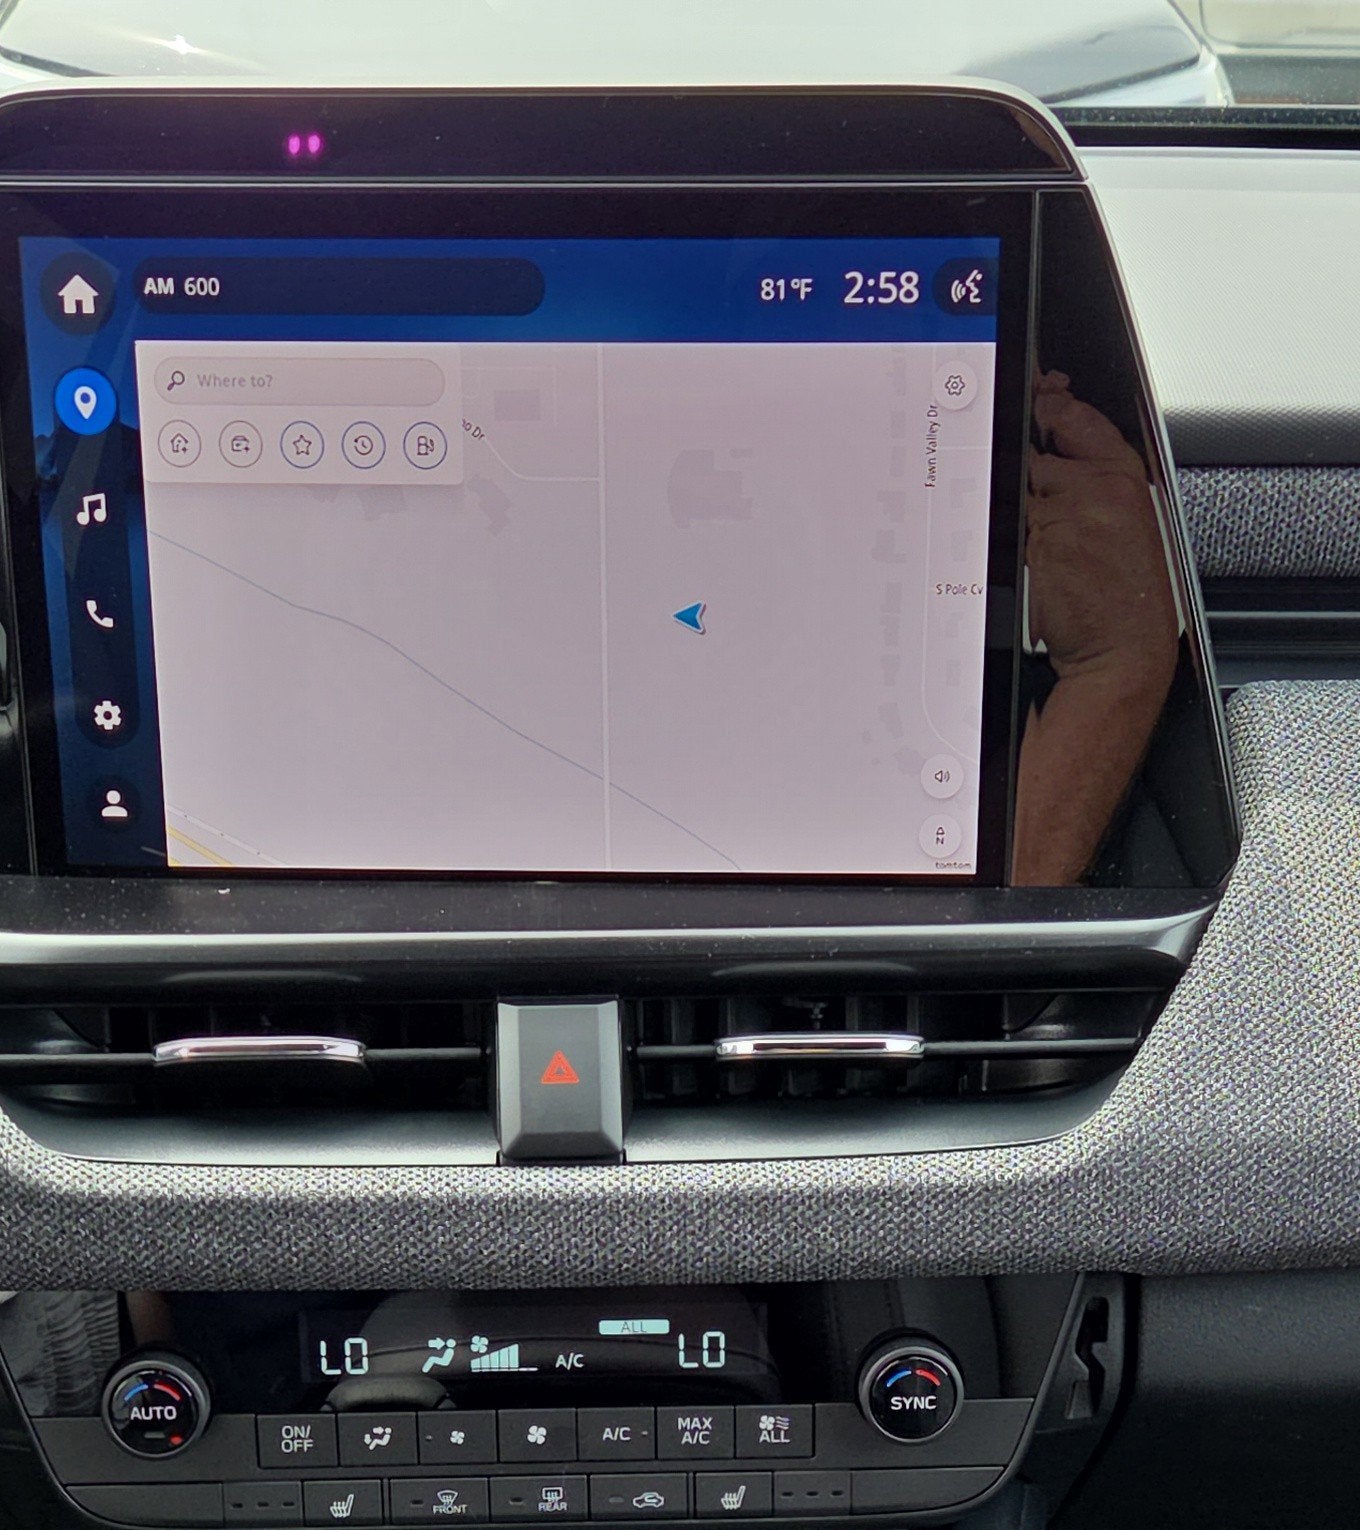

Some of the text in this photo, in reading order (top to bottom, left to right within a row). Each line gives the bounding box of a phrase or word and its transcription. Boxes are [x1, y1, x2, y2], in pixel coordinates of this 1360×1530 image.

[143, 277, 220, 296] AM 600
[844, 270, 920, 306] 2:58
[196, 372, 273, 388] Where to?
[927, 405, 938, 417] Dr
[926, 421, 941, 455] Valley
[620, 1321, 647, 1332] ALL
[556, 1352, 584, 1370] A/C
[891, 1395, 937, 1411] SYNC
[130, 1405, 177, 1421] AUTO
[678, 1417, 713, 1430] MAX
[295, 1425, 312, 1439] ON/
[603, 1427, 631, 1441] A/C
[682, 1430, 711, 1444] A/C
[759, 1430, 790, 1443] ALL
[282, 1438, 313, 1453] OFF
[433, 1503, 467, 1515] FRONT
[538, 1500, 568, 1512] REAR
